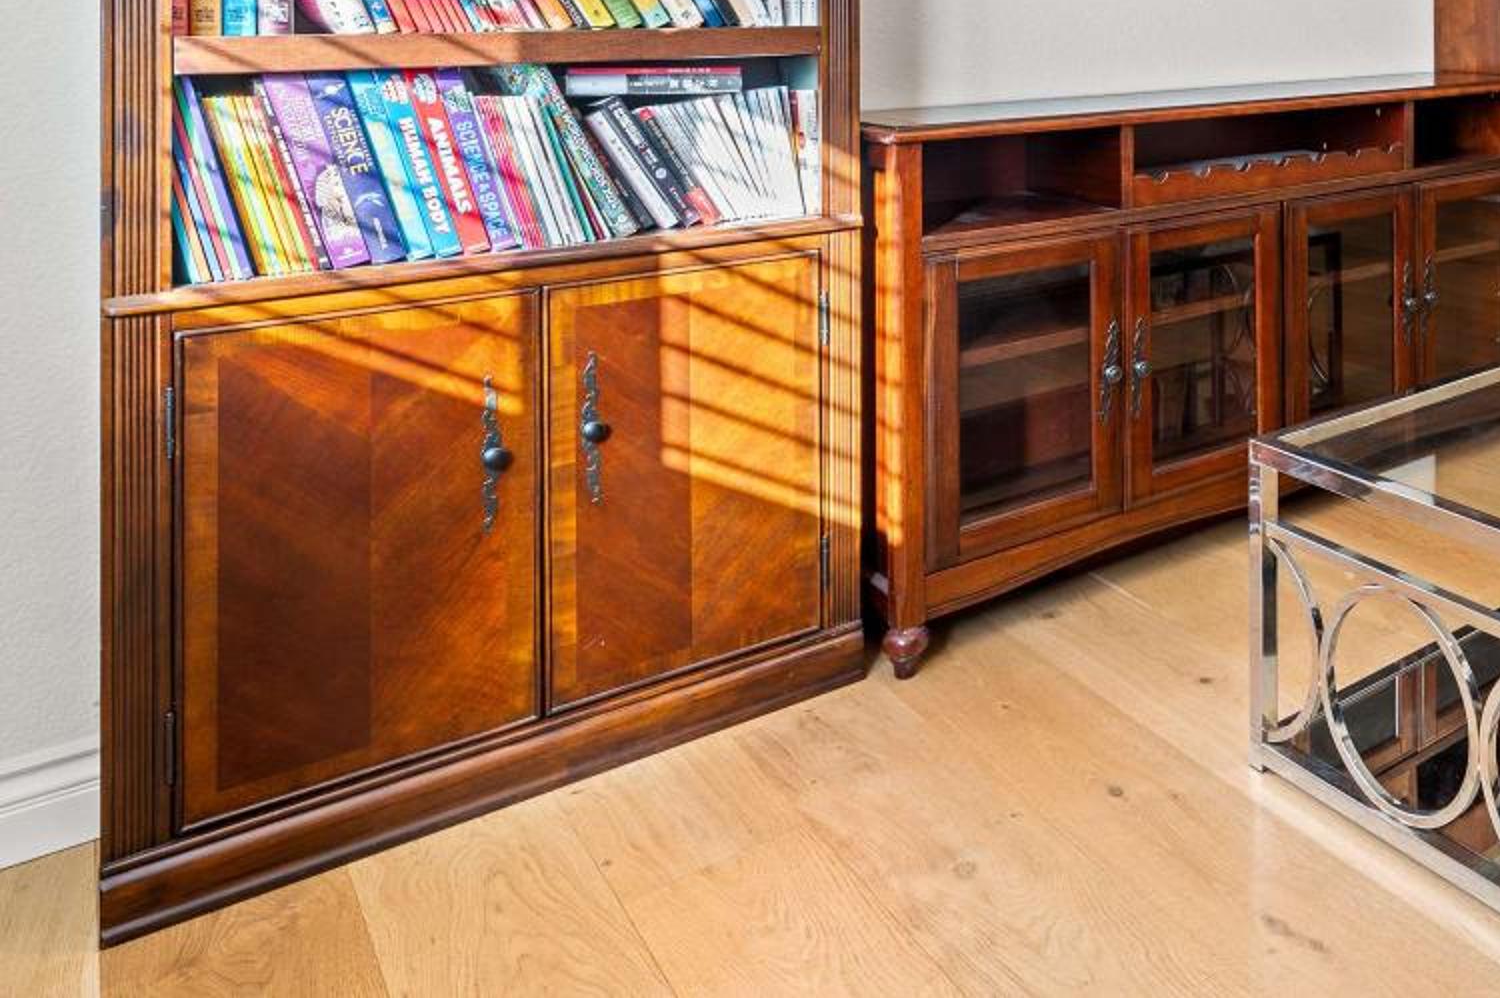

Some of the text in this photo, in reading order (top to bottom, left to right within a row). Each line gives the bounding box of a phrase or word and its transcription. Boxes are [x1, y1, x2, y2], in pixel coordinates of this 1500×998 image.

[331, 107, 369, 175] SCIENCE
[400, 116, 432, 184] HUMAN
[422, 186, 450, 234] BODY
[427, 117, 473, 215] ANIMALS
[456, 120, 491, 185] SCIENCE
[480, 191, 508, 239] SPACE
